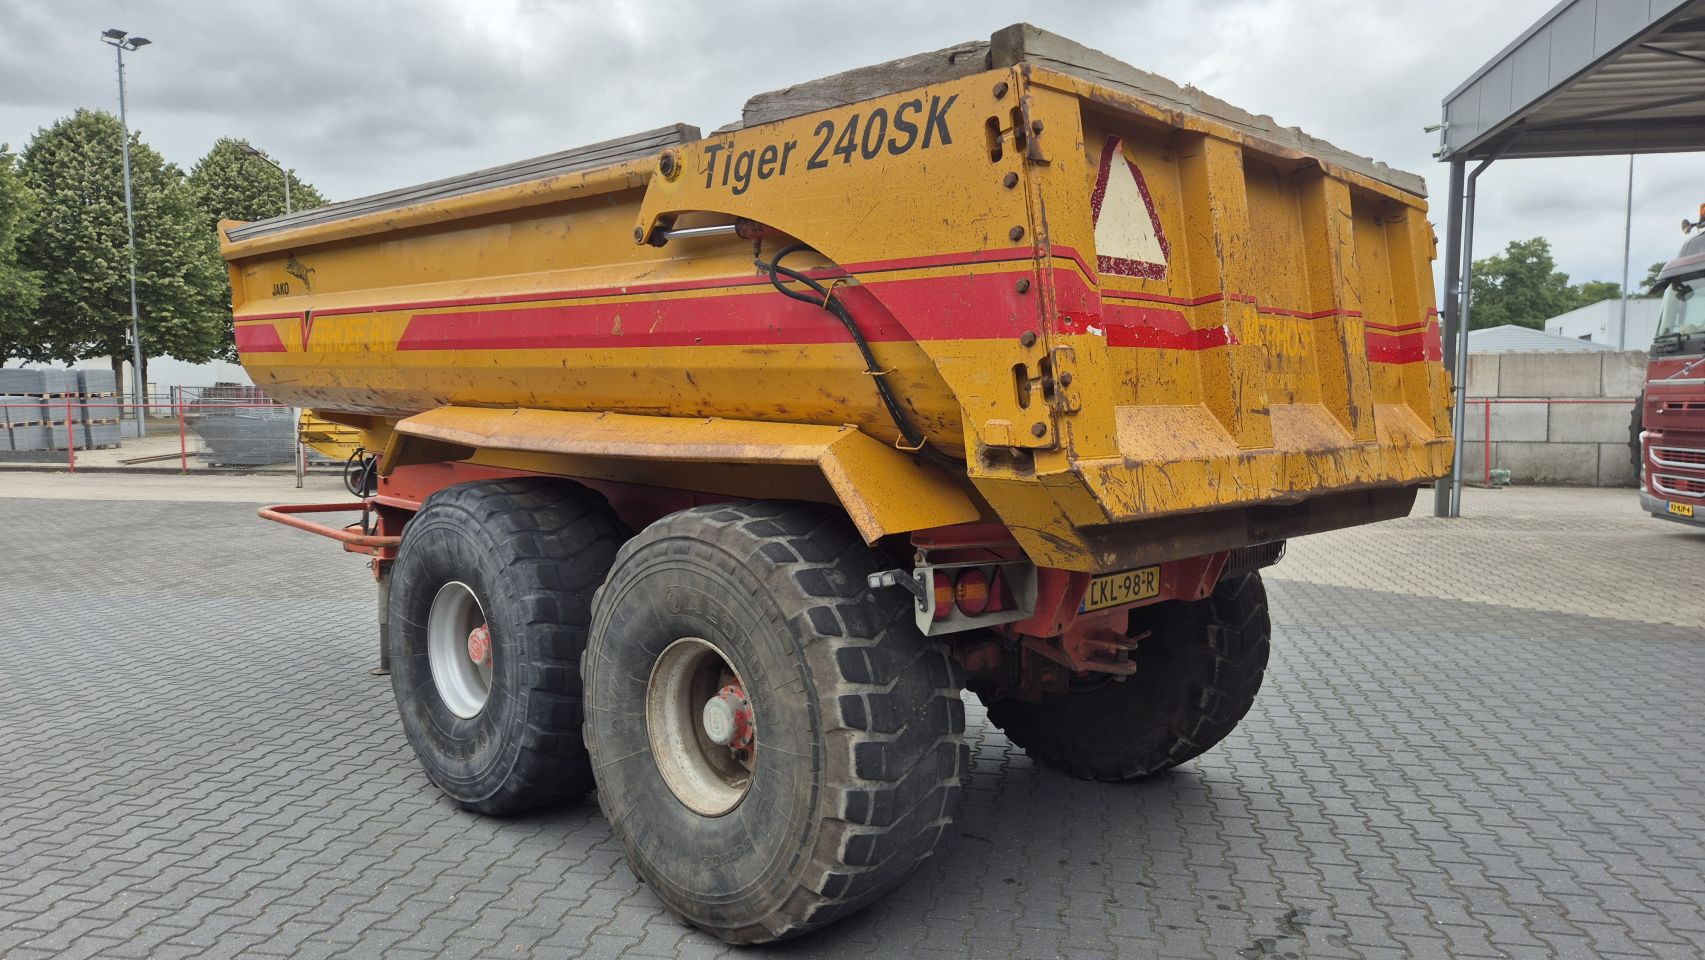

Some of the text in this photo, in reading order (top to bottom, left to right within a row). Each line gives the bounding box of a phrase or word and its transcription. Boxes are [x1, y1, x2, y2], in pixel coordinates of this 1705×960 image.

[703, 93, 959, 196] Tiger 240SK
[271, 281, 289, 296] JAKO
